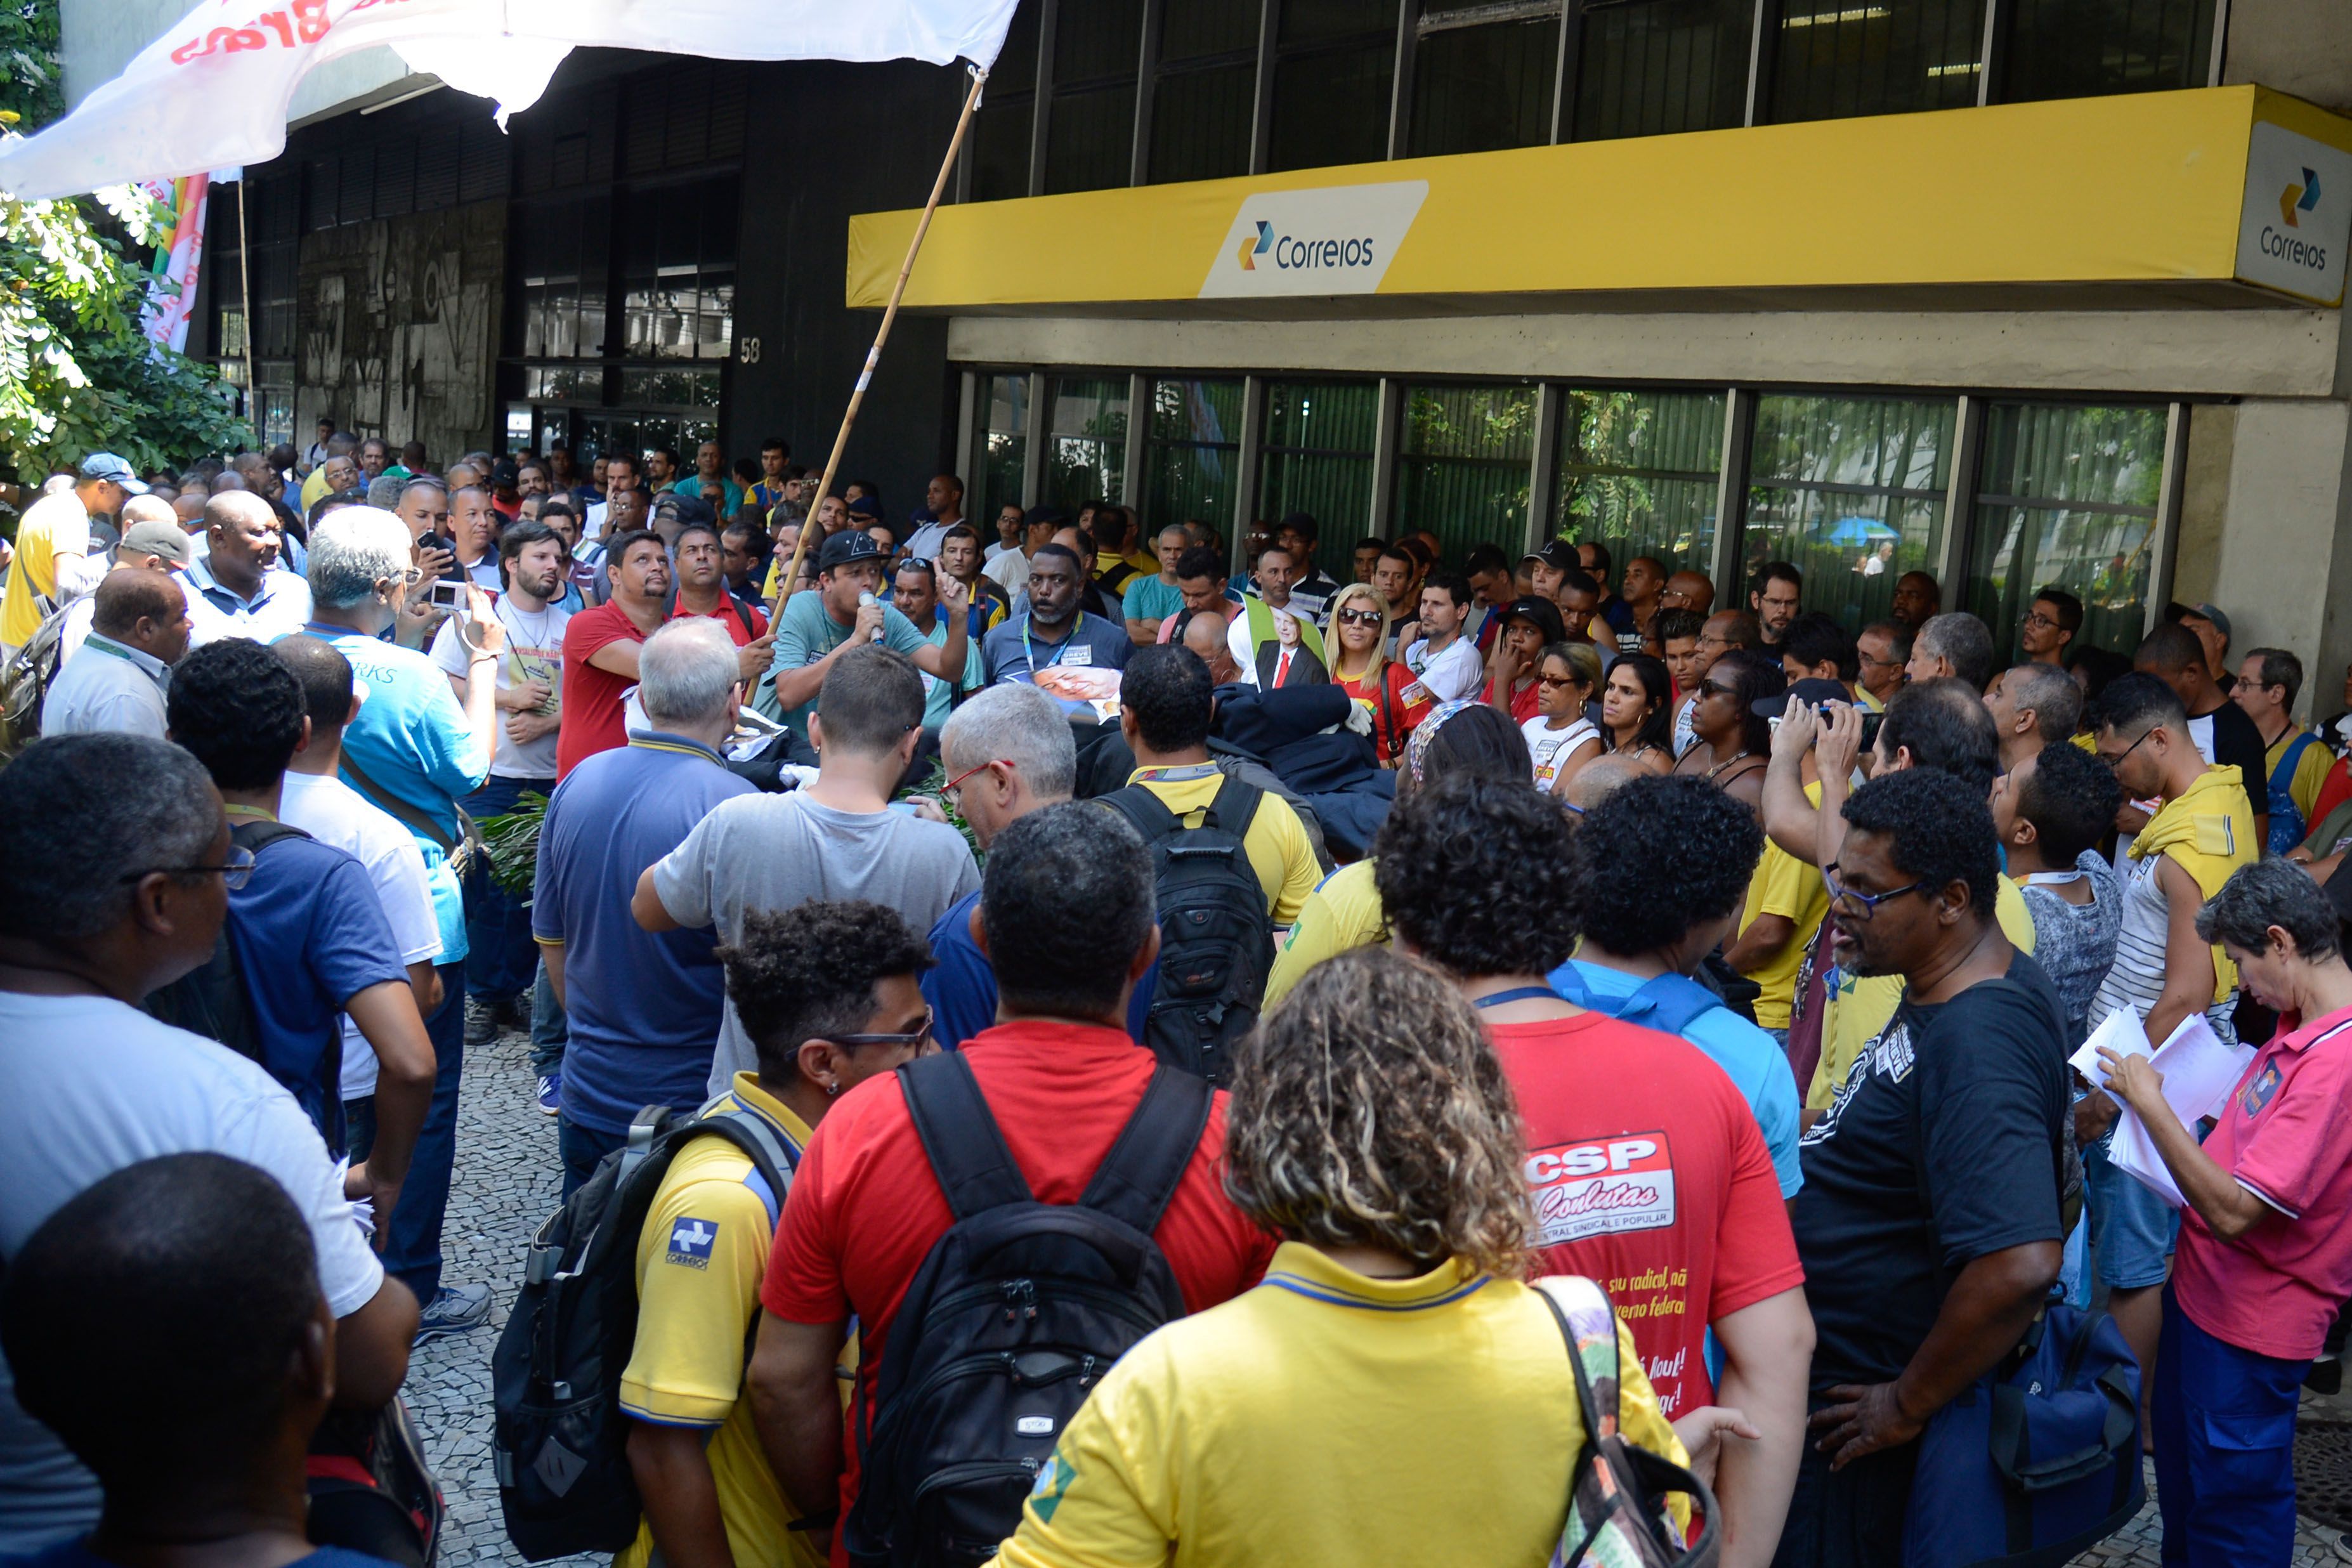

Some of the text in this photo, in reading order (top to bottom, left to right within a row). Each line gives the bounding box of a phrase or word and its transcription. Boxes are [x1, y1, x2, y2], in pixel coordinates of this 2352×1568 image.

[1276, 235, 1373, 269] Correios
[2261, 226, 2326, 270] Correios
[741, 337, 760, 363] 58
[1525, 1140, 1656, 1184] CSP
[1539, 1180, 1658, 1225] Conlutas
[1573, 1219, 1612, 1233] SINDICAL
[1623, 1214, 1666, 1225] POPULAR
